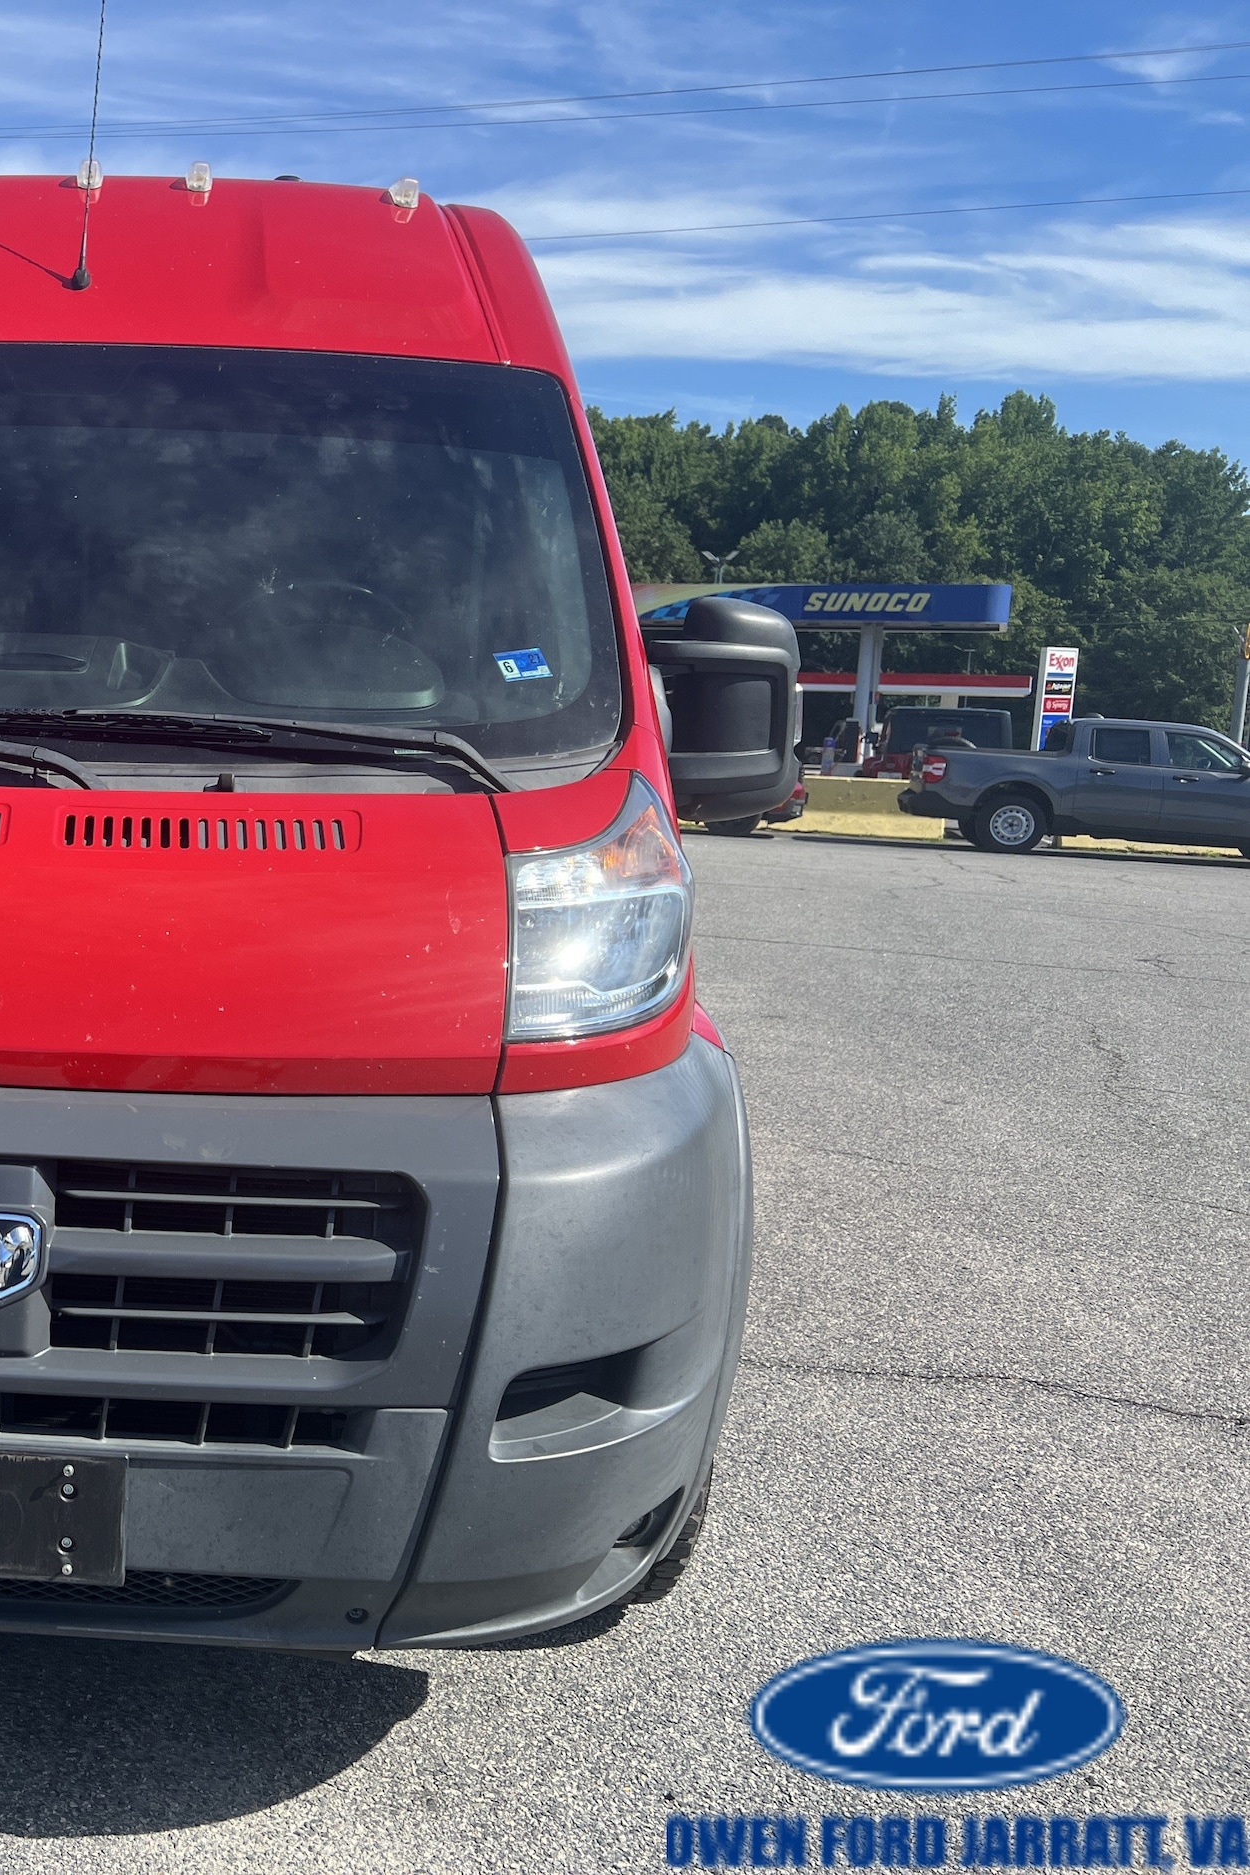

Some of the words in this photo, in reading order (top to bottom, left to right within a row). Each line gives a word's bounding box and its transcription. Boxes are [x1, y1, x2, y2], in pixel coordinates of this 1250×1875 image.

[804, 592, 931, 612] SUNOCO
[528, 653, 541, 664] 27
[1049, 653, 1075, 671] Exxon
[503, 661, 514, 673] 6
